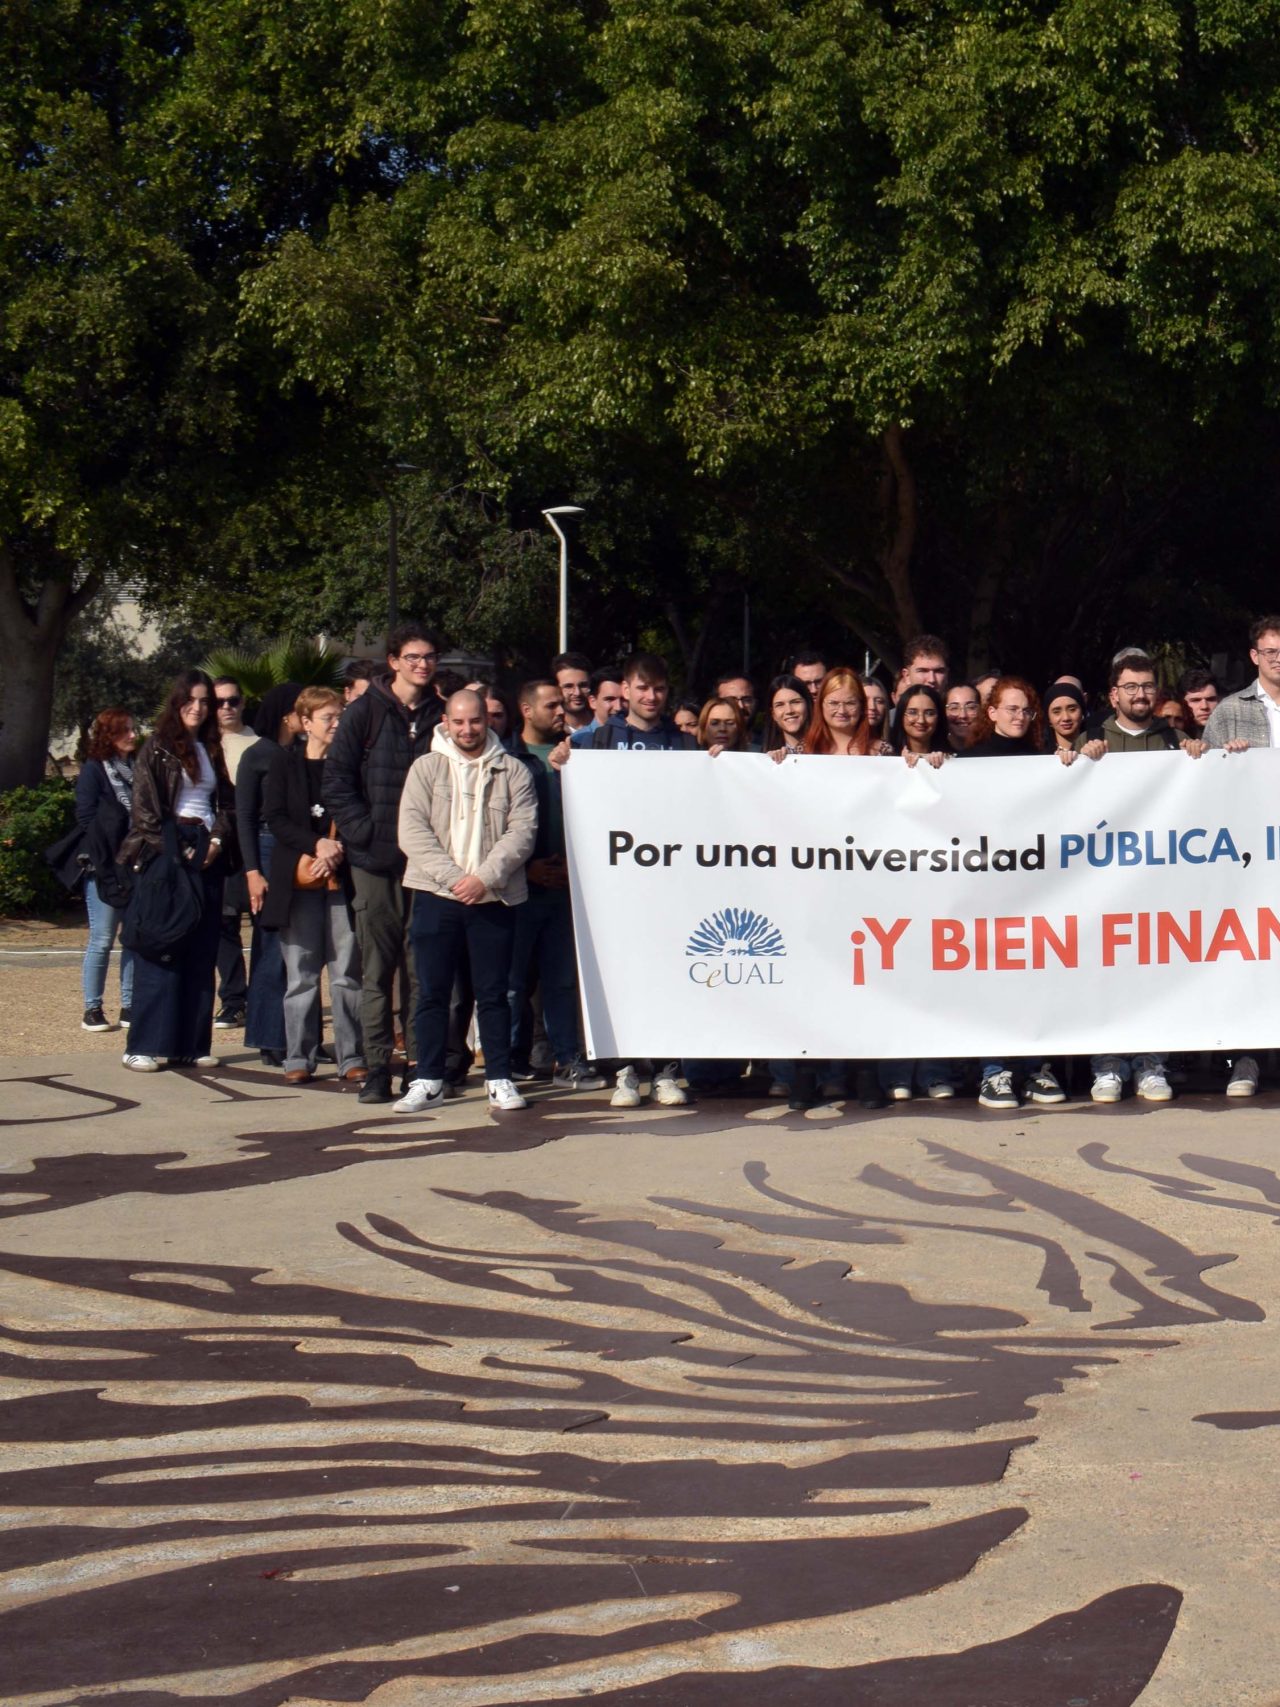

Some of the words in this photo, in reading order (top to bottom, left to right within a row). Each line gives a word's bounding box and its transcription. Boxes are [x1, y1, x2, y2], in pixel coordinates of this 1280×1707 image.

[609, 831, 682, 867] Por
[696, 845, 776, 868] una
[792, 834, 1045, 872] universidad
[1060, 820, 1251, 868] PÚBLICA,
[851, 917, 912, 985] ¡Y
[932, 915, 1078, 971] BIEN
